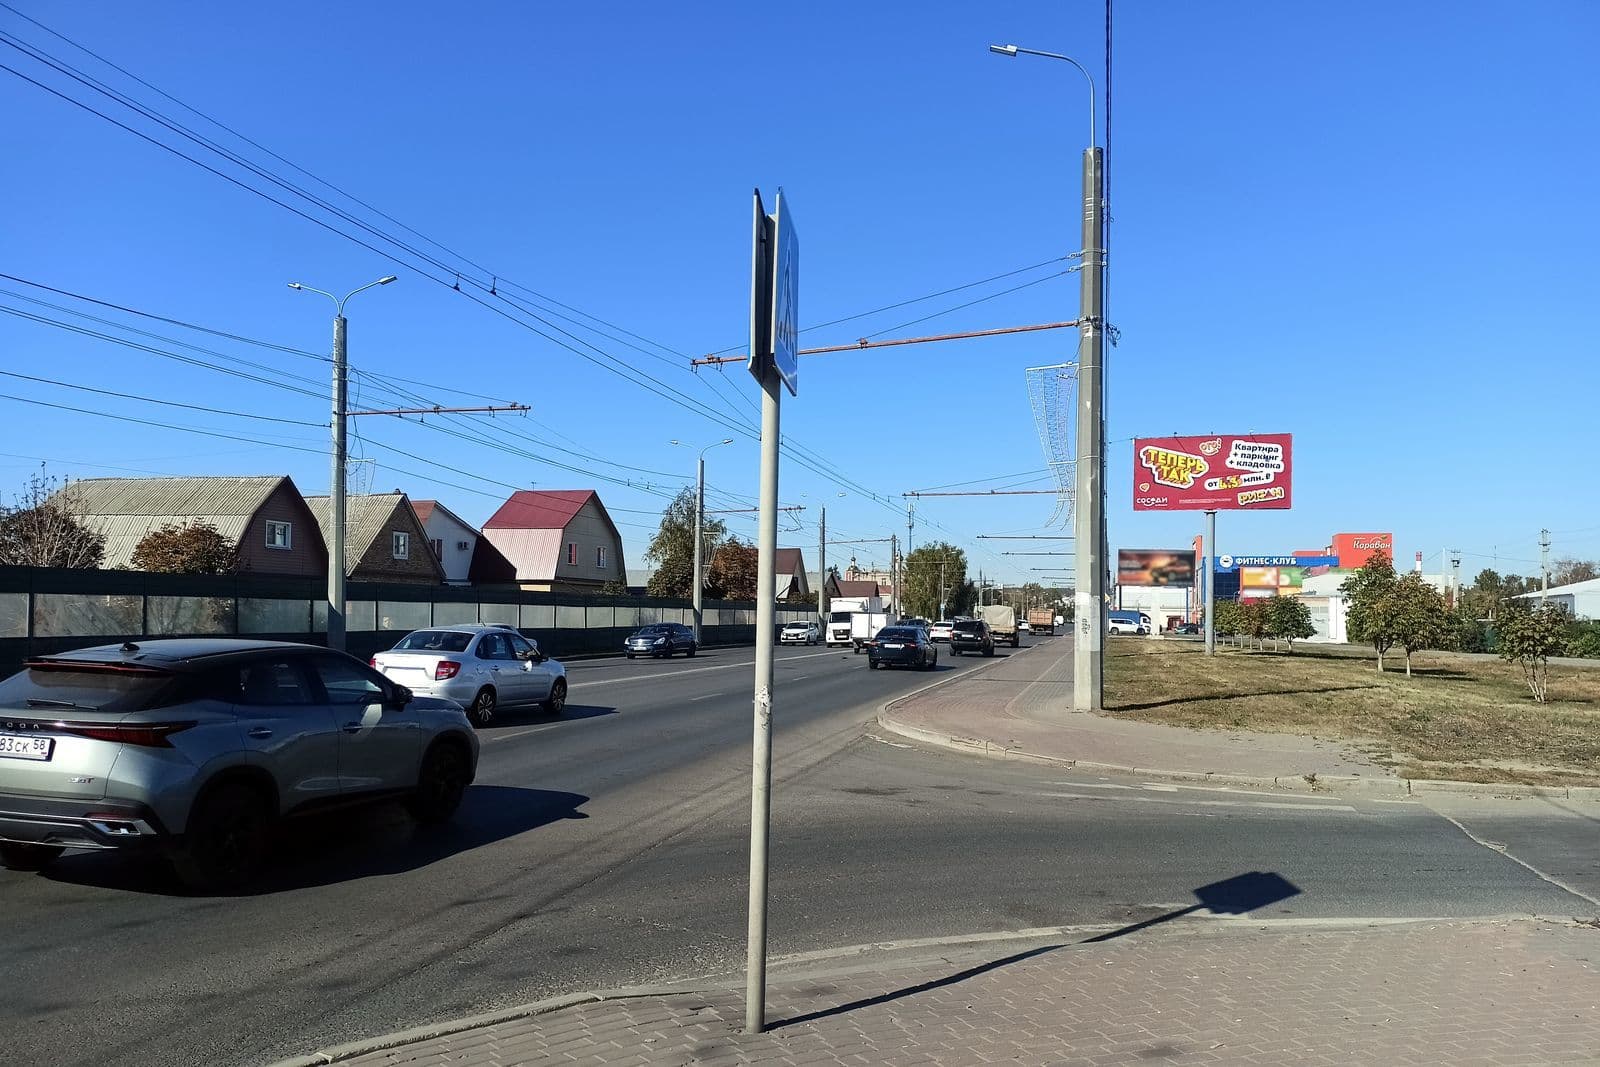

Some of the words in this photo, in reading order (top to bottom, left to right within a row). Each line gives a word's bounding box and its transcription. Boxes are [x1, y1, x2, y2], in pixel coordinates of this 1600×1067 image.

[1234, 443, 1279, 453] Квартира
[1146, 449, 1205, 473] ТЕПЕРЬ
[1240, 452, 1279, 461] паркинг
[1236, 460, 1281, 470] кладовка
[1158, 466, 1191, 483] ТАК
[1353, 540, 1391, 550] Караван
[33, 739, 46, 750] 58
